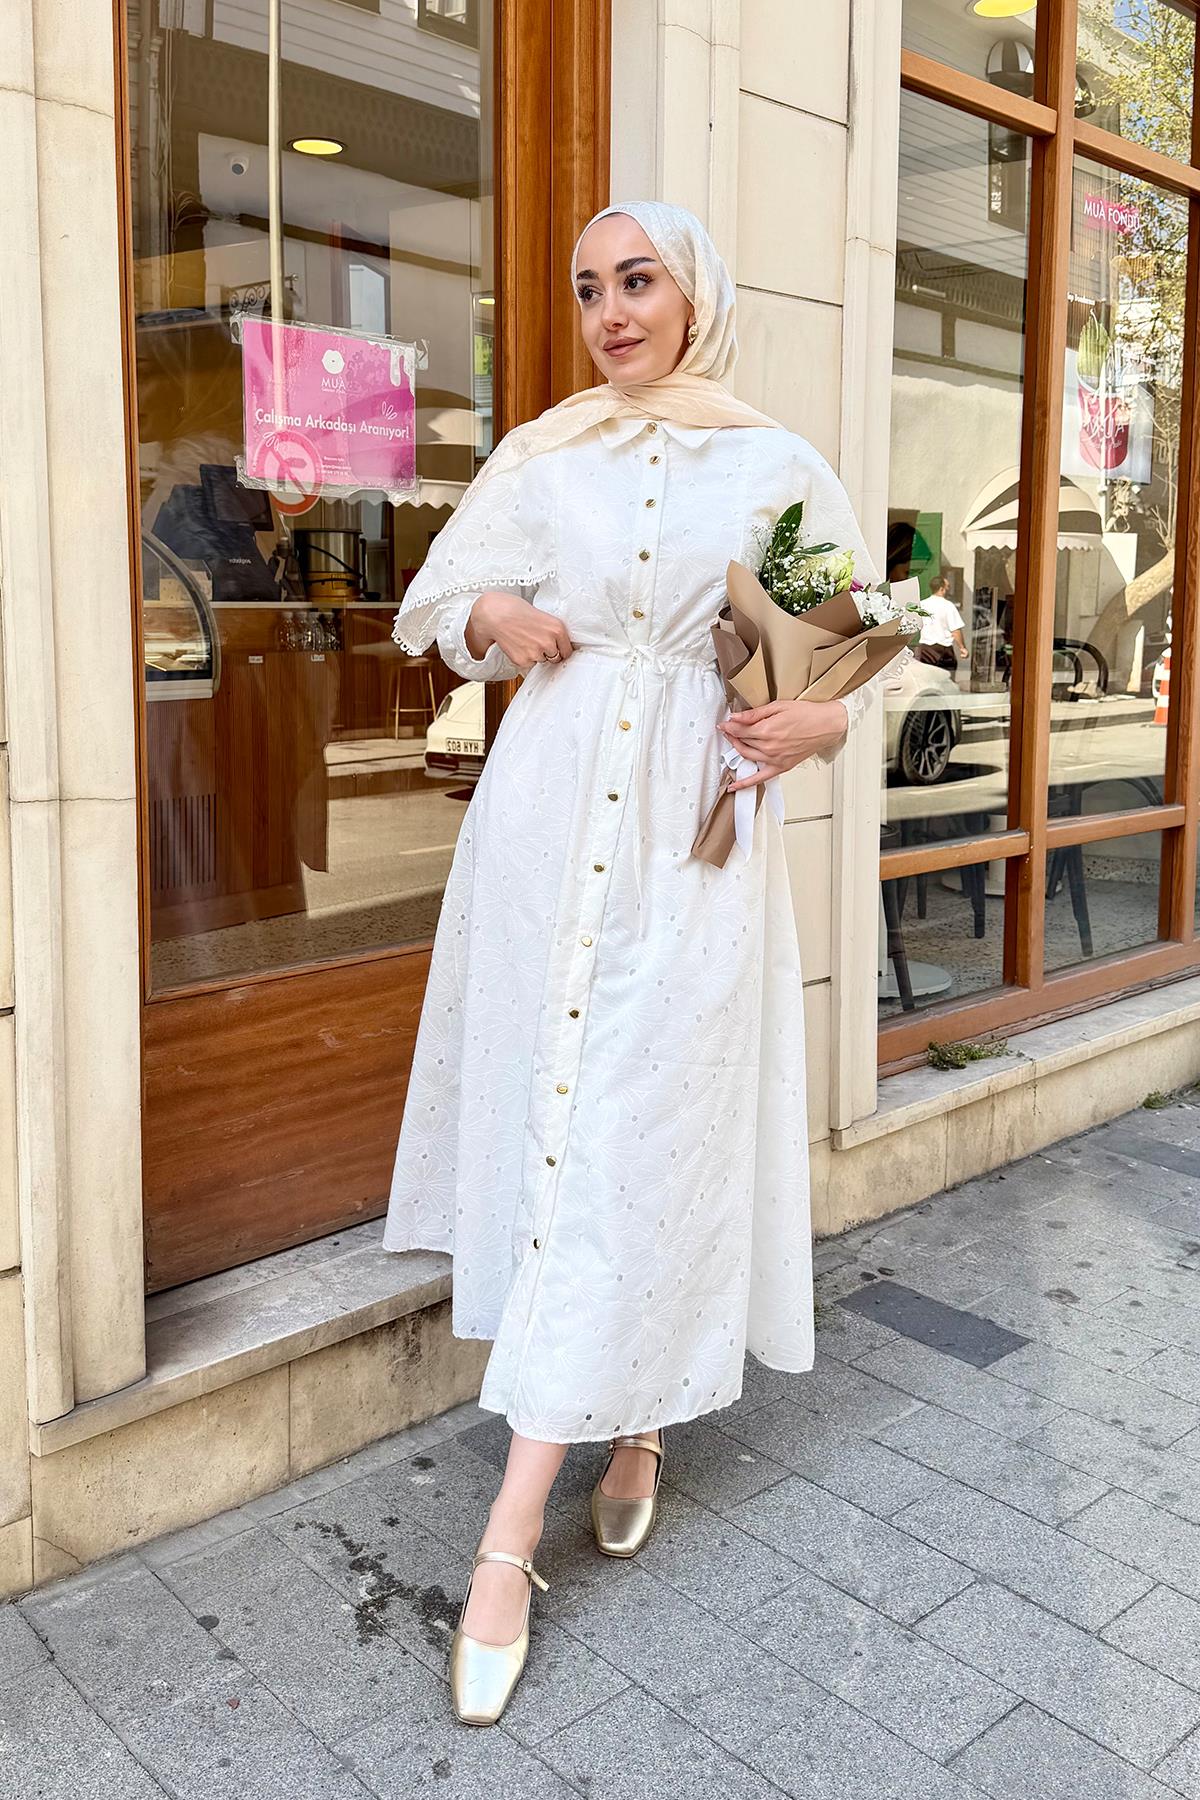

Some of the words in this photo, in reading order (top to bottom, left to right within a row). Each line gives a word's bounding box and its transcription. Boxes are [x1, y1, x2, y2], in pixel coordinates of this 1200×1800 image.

[1083, 199, 1106, 221] MUÀ
[255, 408, 301, 427] Çalışma
[305, 414, 357, 434] Arkadaşı
[361, 420, 410, 440] Aranıyor!
